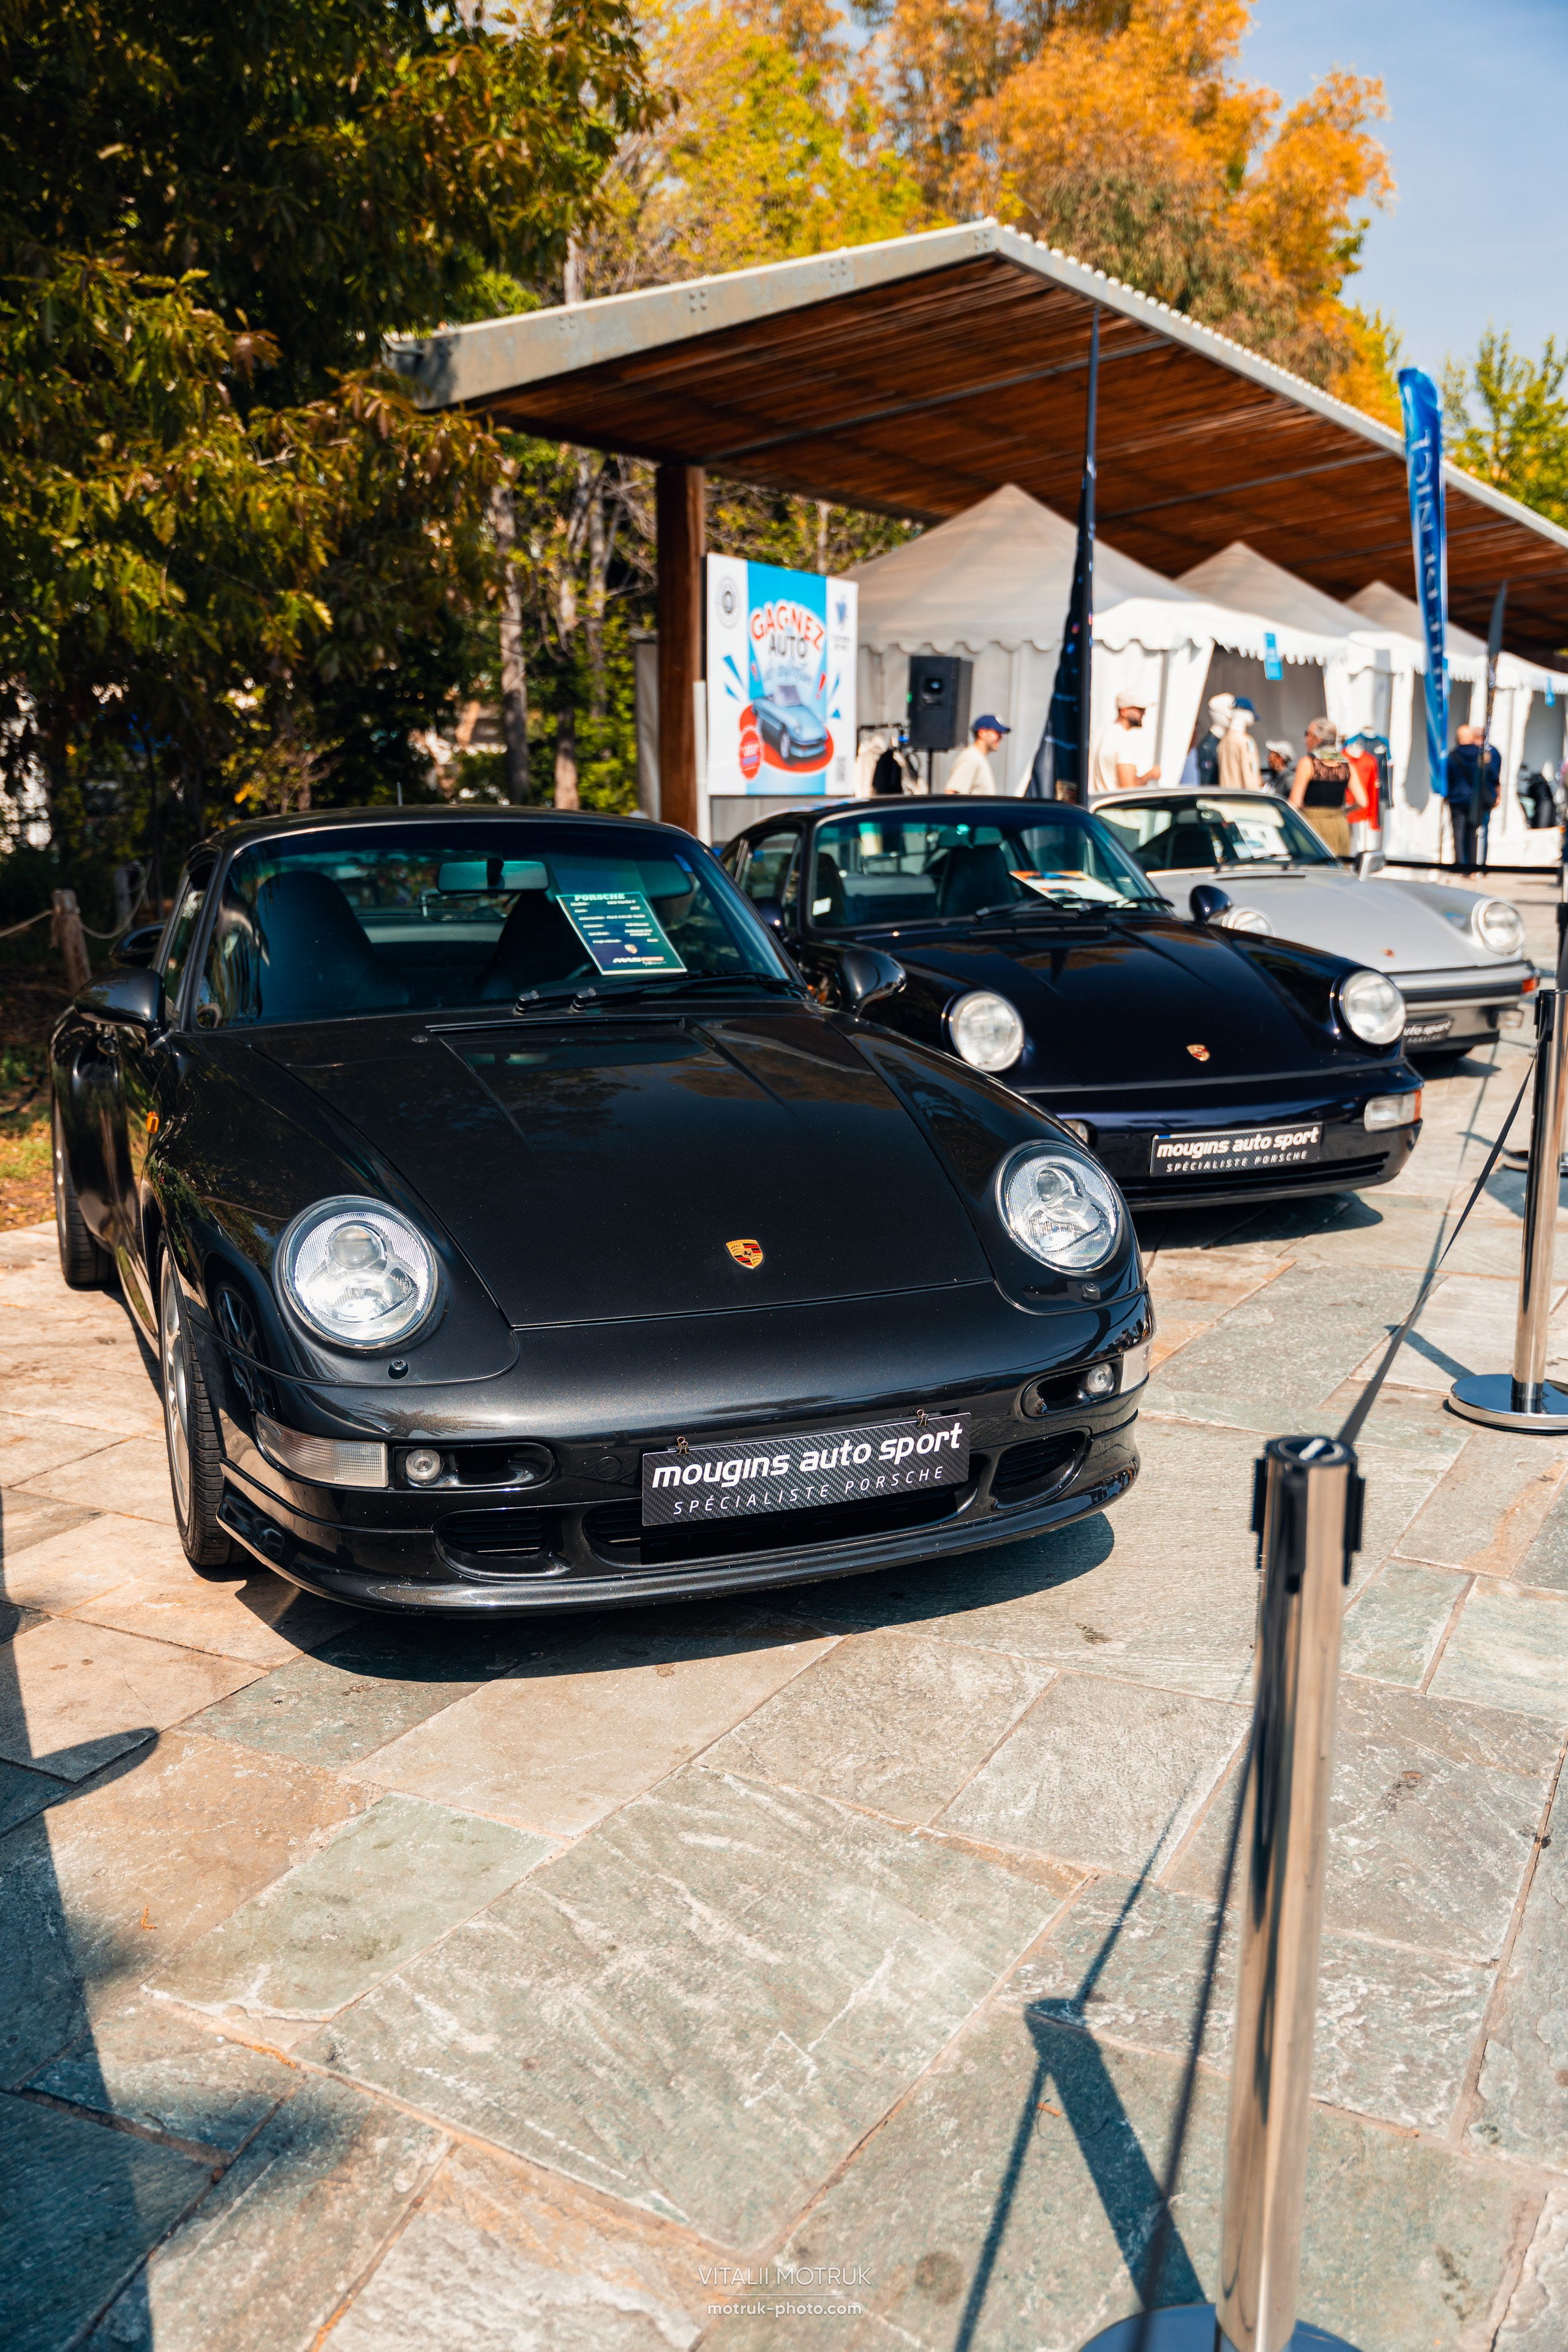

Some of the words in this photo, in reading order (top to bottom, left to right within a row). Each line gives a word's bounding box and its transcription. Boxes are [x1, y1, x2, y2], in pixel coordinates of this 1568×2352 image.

[752, 606, 824, 652] GAGNEZ
[768, 633, 808, 658] AUTO
[1403, 1023, 1423, 1036] uto
[1156, 1139, 1231, 1159] mougins
[1232, 1133, 1272, 1152] auto
[1273, 1126, 1320, 1151] sport
[1166, 1156, 1250, 1172] SPÉCIALISTE
[1254, 1150, 1308, 1165] PORSCHE
[652, 1453, 790, 1488] mougins
[799, 1439, 872, 1472] auto
[878, 1422, 963, 1465] sport
[673, 1484, 829, 1515] SPÉCIALISTE
[845, 1466, 944, 1494] PORSCHE
